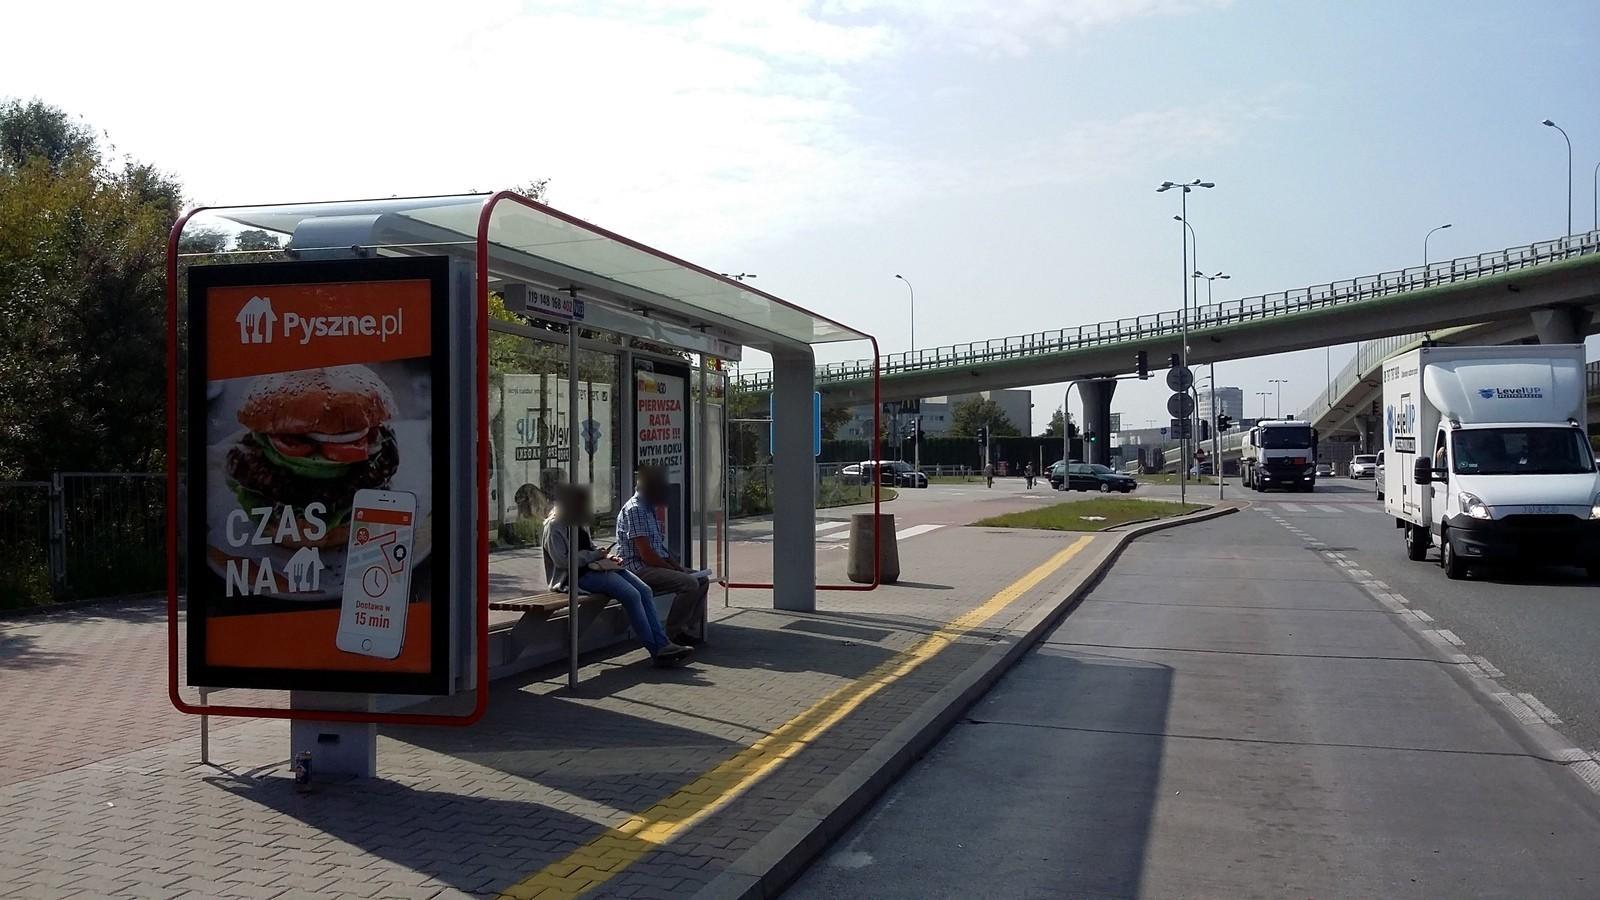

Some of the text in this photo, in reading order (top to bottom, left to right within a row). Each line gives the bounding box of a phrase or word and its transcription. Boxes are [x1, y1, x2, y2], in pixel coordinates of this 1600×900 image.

[528, 289, 538, 304] 119
[283, 307, 403, 345] Pyszne.pl
[1496, 386, 1541, 394] LevelUP
[639, 399, 682, 412] PIERWSZA
[649, 414, 671, 427] RATA
[1393, 404, 1416, 434] LevelUP
[639, 428, 671, 442] GRATIS
[663, 442, 682, 454] ROKU
[224, 501, 328, 548] CZAS
[225, 556, 280, 598] NA
[356, 600, 384, 612] Dostawa
[354, 611, 390, 629] 15 min
